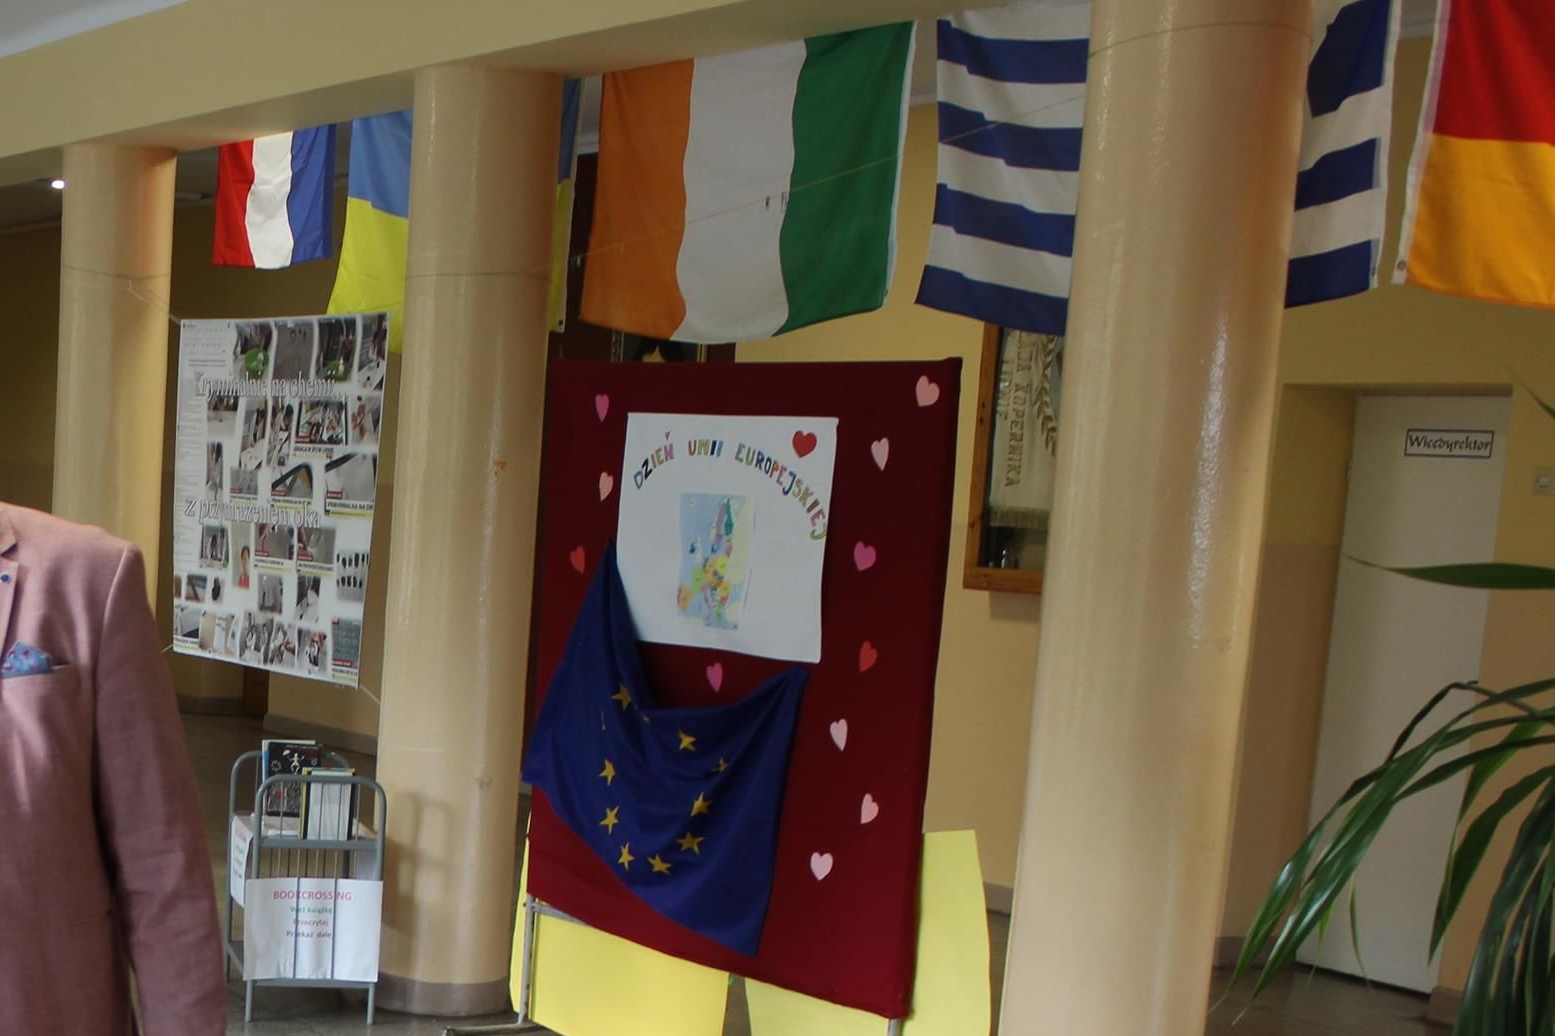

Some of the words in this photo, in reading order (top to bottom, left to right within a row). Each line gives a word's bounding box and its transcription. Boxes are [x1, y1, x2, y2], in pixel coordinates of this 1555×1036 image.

[271, 378, 288, 398] na
[1409, 435, 1491, 452] Wicedyrektor
[633, 431, 674, 490] DZIEŃ
[688, 439, 724, 458] UNII
[734, 442, 827, 540] EUROPEJSKIEJ
[294, 503, 320, 528] oka
[273, 890, 352, 901] BOOCROSSNG
